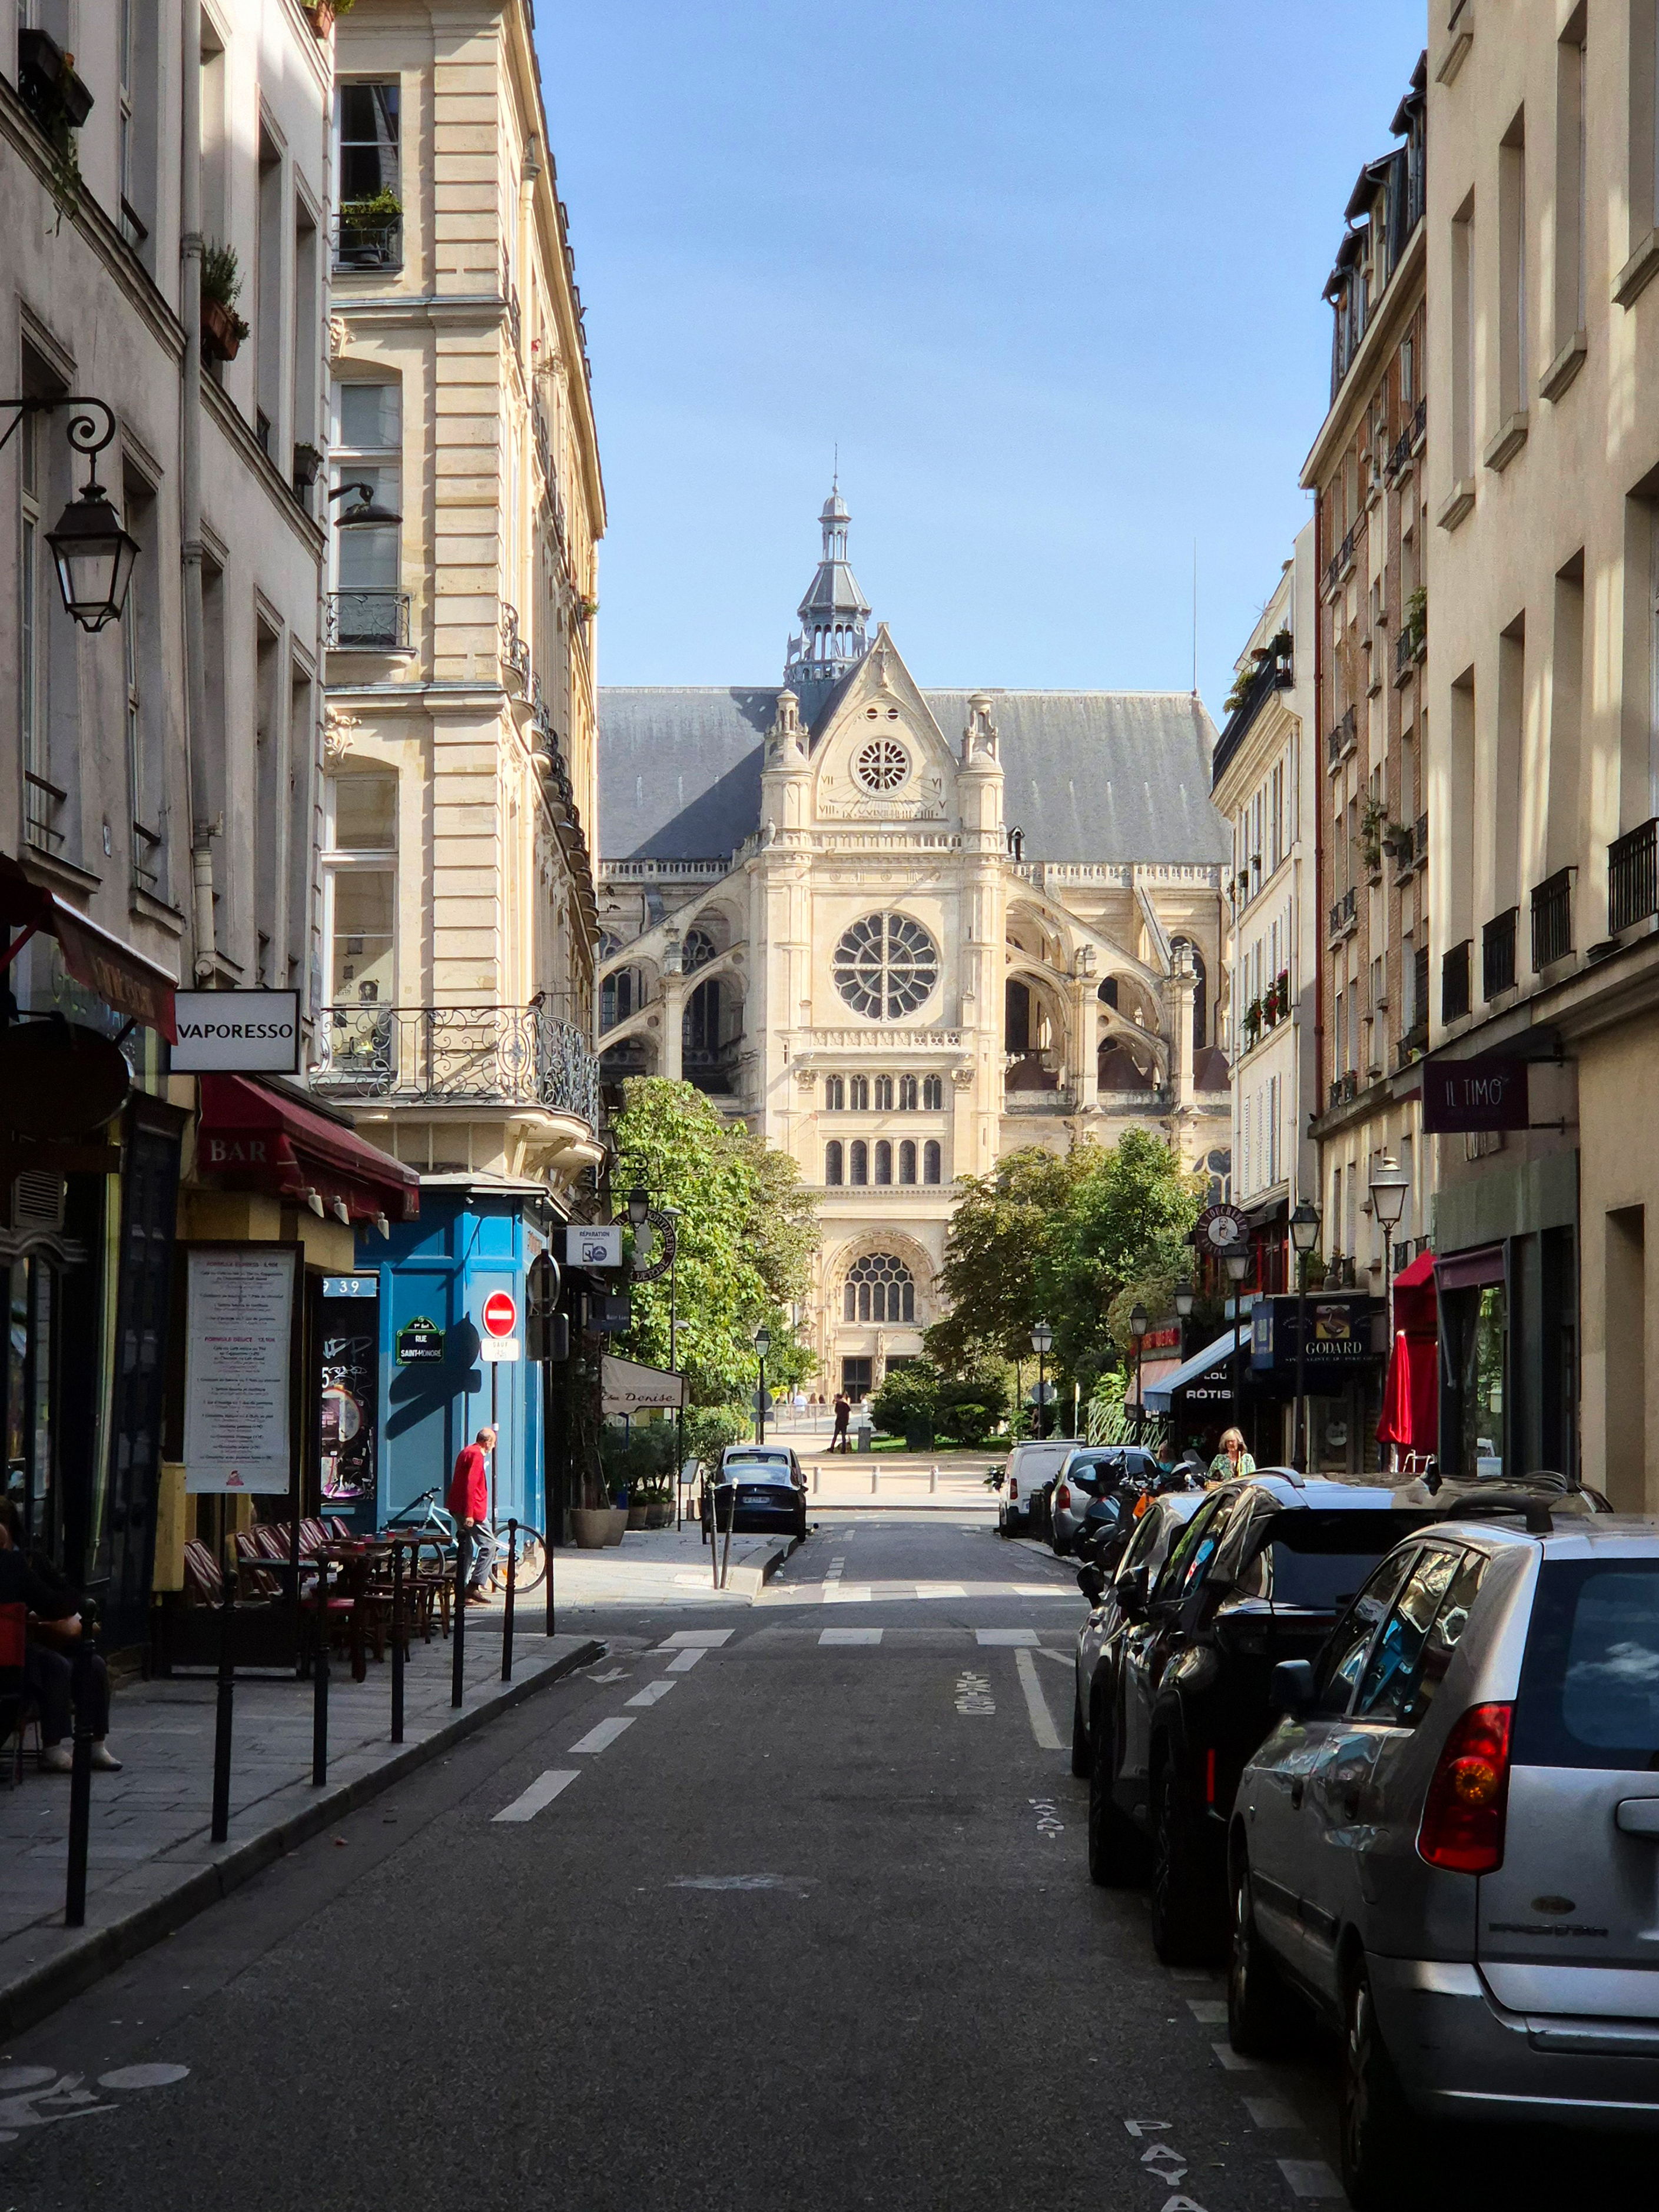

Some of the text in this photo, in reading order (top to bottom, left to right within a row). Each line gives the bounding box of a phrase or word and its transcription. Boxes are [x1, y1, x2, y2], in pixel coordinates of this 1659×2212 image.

[178, 1024, 293, 1039] VAPORESSO
[1446, 1078, 1502, 1107] IL TIMO
[210, 1139, 267, 1163] BAR
[340, 1280, 359, 1293] 39
[415, 1334, 427, 1343] RUE
[400, 1349, 442, 1358] SAINT-HONORÉ
[1305, 1341, 1363, 1355] GODARD
[625, 1393, 675, 1402] Denise
[1186, 1387, 1235, 1399] RÔTIS
